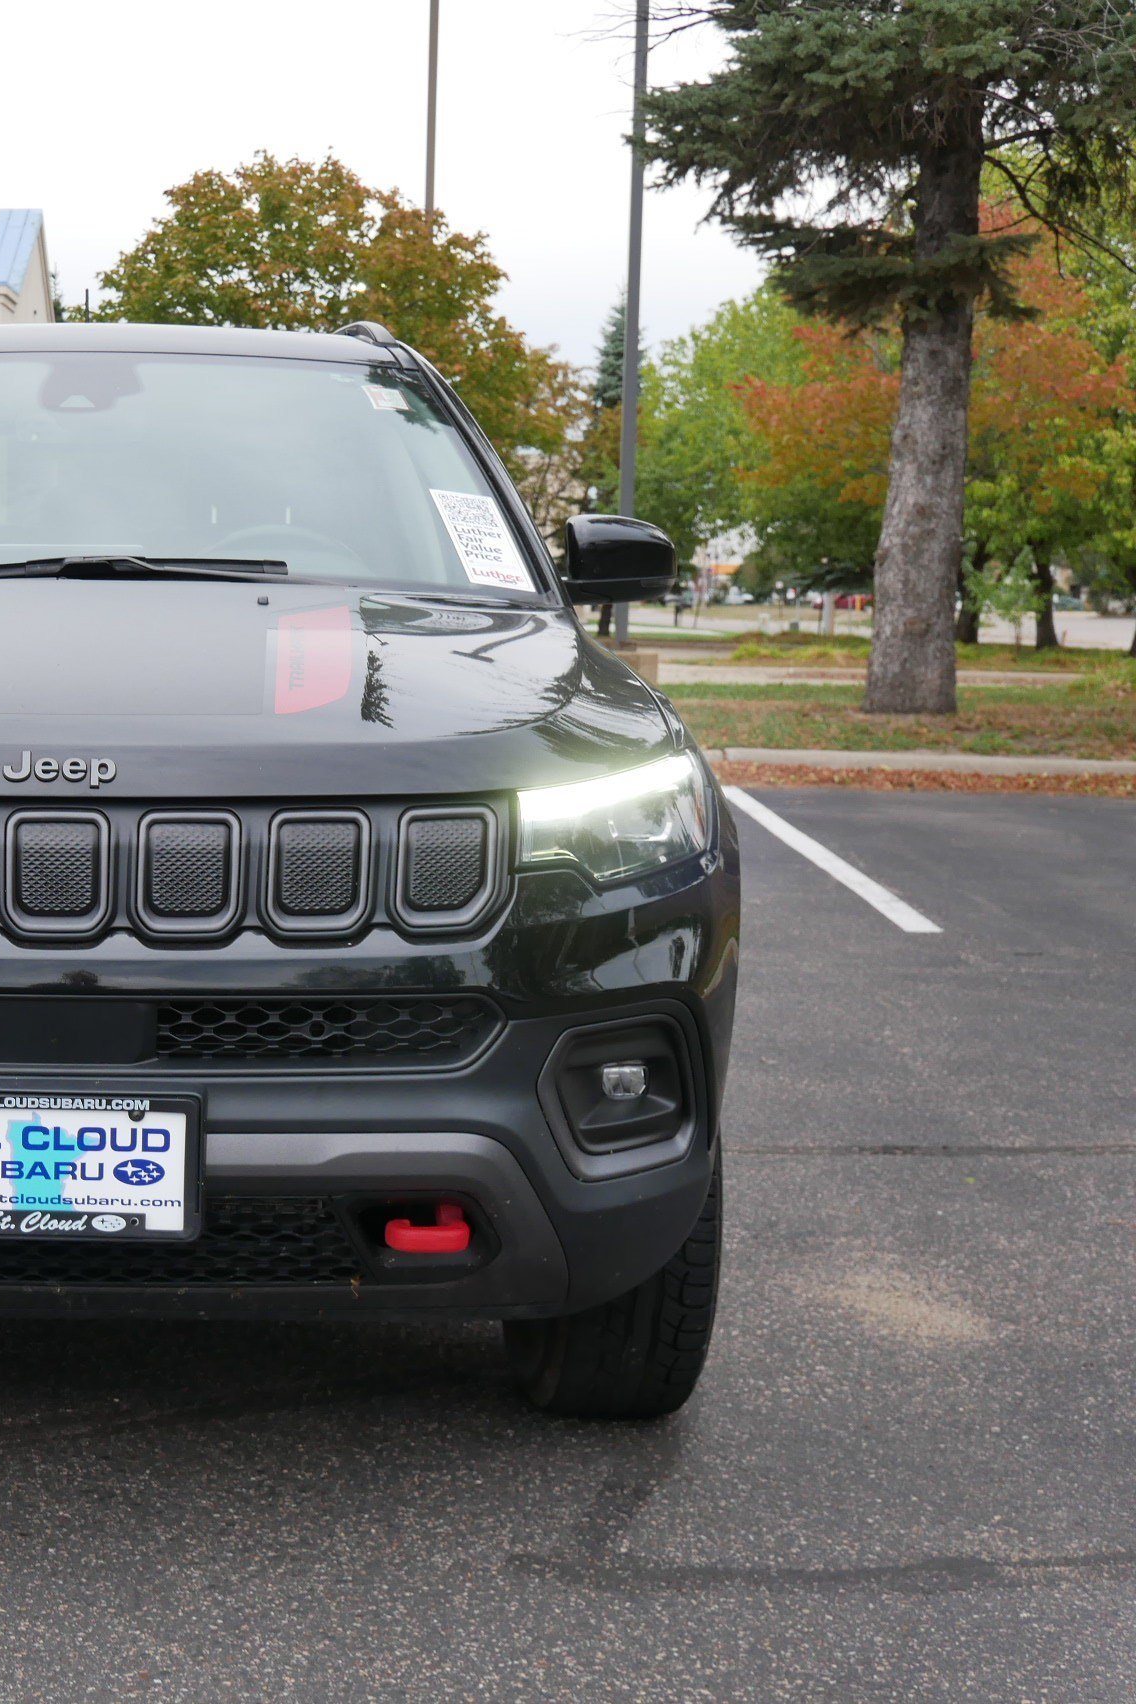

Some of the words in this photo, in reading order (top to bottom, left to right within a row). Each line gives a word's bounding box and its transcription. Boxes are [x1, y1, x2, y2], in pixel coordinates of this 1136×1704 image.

[453, 525, 503, 540] Luther
[457, 533, 484, 544] Fair
[459, 541, 503, 555] Value
[464, 549, 503, 562] Price
[471, 567, 523, 582] Luther
[2, 750, 117, 789] Jeep
[21, 1125, 171, 1153] CLOUD
[19, 1211, 87, 1233] Cloud
